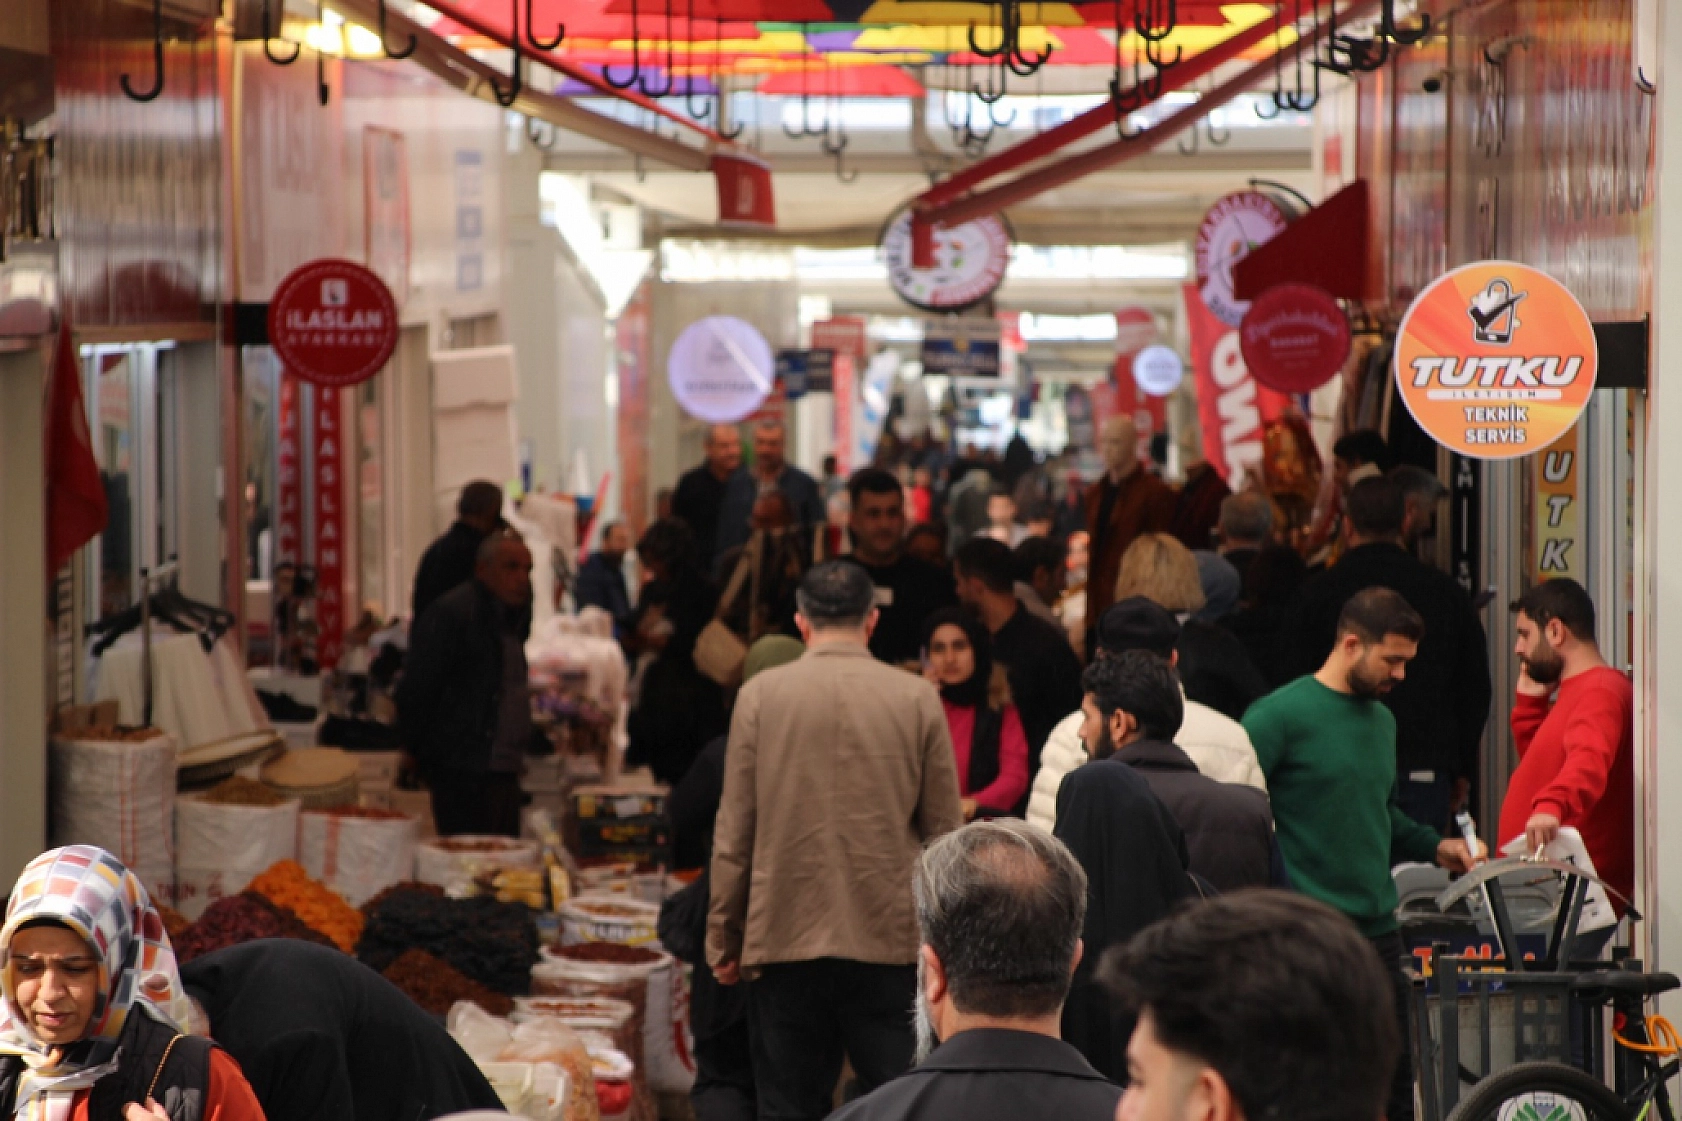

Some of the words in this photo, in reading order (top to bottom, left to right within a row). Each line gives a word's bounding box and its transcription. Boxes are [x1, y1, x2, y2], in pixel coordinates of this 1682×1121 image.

[1409, 355, 1585, 387] TUTKU
[1463, 402, 1530, 423] TEKNİK
[1465, 424, 1528, 444] SERVİS
[1540, 450, 1575, 572] UTK
